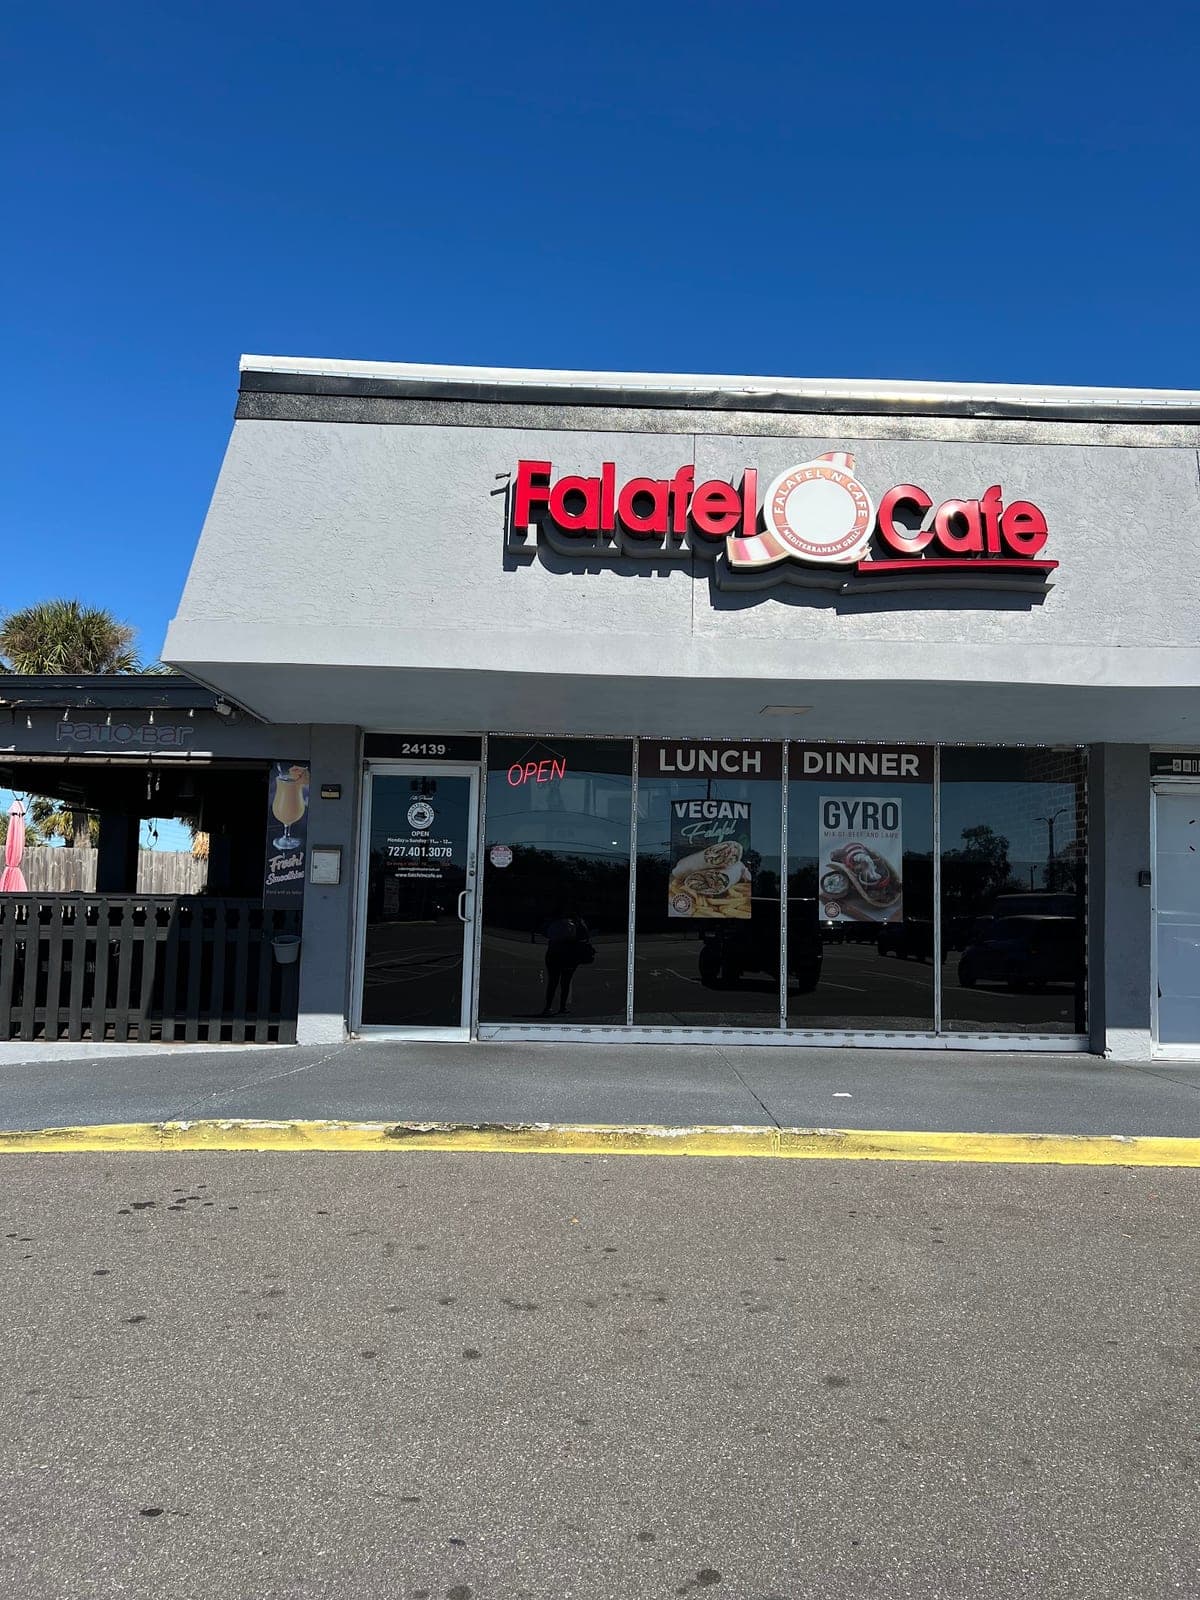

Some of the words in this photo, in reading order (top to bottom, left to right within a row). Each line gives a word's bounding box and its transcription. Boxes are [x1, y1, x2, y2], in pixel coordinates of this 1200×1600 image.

[774, 470, 823, 514] FALAFEL
[847, 483, 868, 518] CAFE
[514, 459, 758, 537] Falafel
[876, 483, 1048, 559] Cafe
[782, 529, 842, 553] MEDITERRANEAN
[843, 530, 860, 547] GRILL
[401, 743, 446, 755] 24139
[659, 748, 761, 773] LUNCH
[508, 759, 566, 786] OPEN
[803, 751, 920, 776] DINNER
[675, 801, 749, 819] VEGAN
[823, 800, 899, 831] GYRO
[680, 819, 737, 844] Falafel
[387, 846, 453, 857] 727.401.3078
